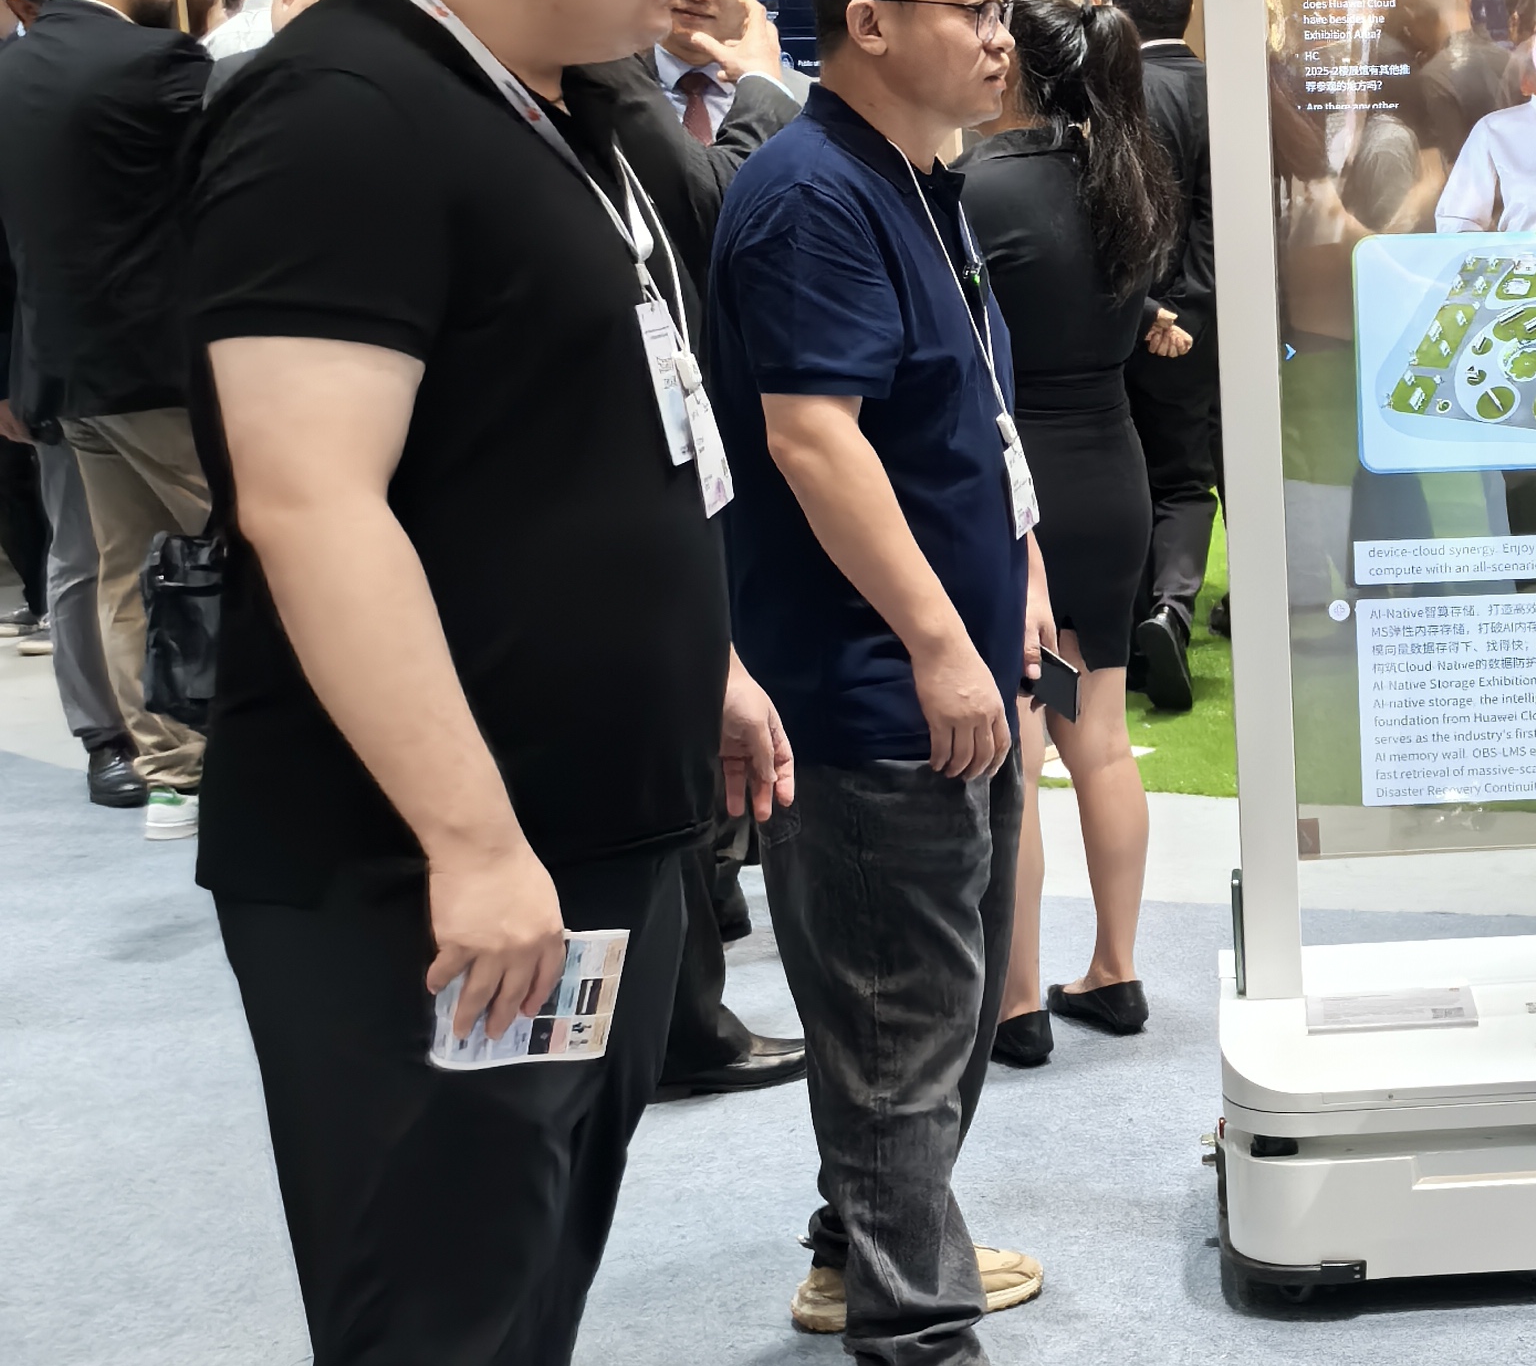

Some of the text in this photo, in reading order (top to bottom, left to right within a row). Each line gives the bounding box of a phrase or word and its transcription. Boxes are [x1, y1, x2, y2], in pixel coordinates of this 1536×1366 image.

[1303, 0, 1328, 9] does
[1303, 14, 1328, 25] have
[1304, 51, 1320, 61] HC
[1368, 544, 1445, 558] device-cloud
[1503, 543, 1535, 556] Enjoy
[1369, 565, 1422, 578] compute
[1426, 563, 1451, 575] with
[1455, 564, 1470, 574] an
[1430, 678, 1475, 690] Storage
[1479, 675, 1536, 687] Exhibition
[1480, 694, 1498, 705] the
[1374, 715, 1439, 727] foundation
[1442, 713, 1471, 724] from
[1474, 711, 1517, 723] Huawei
[1375, 734, 1412, 744] serves
[1416, 734, 1429, 744] as
[1432, 731, 1450, 742] the
[1453, 729, 1511, 743] industry's
[1375, 752, 1386, 762] AI
[1389, 751, 1438, 763] memory
[1376, 769, 1398, 780] fast
[1400, 766, 1450, 779] retrieval
[1452, 766, 1465, 777] of
[1377, 786, 1424, 797] Disaster
[1427, 785, 1481, 797] Recovery
